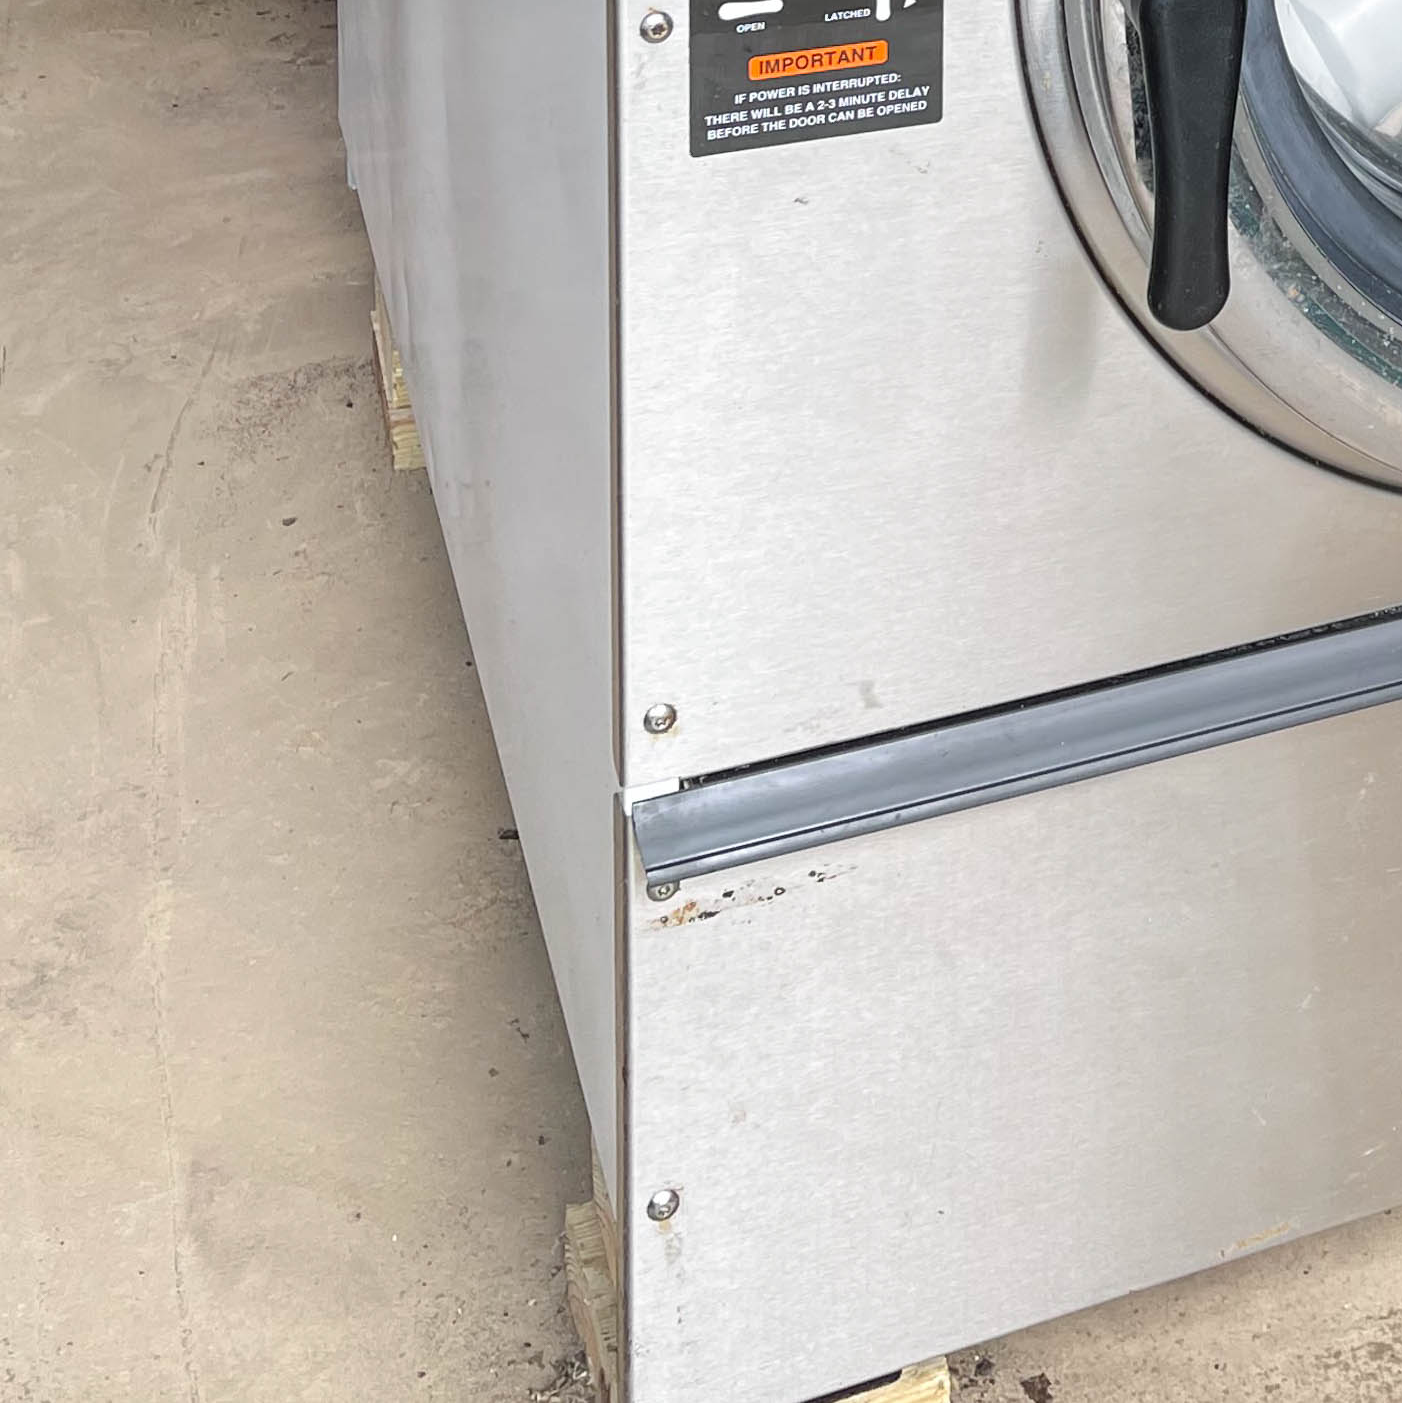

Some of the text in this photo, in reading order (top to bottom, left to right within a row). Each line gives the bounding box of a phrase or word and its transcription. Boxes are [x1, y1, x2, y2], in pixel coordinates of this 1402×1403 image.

[737, 22, 765, 33] OPEN
[825, 9, 871, 21] LATCHED
[760, 46, 877, 74] IMPORTANT
[734, 74, 902, 104] IF POWER IS INTERRUPTED:
[705, 86, 929, 126] THERE WILL BE A 2-3 MINUTE DELAY
[707, 101, 927, 140] BEFORE THE DOOR CAN BE OPENED
